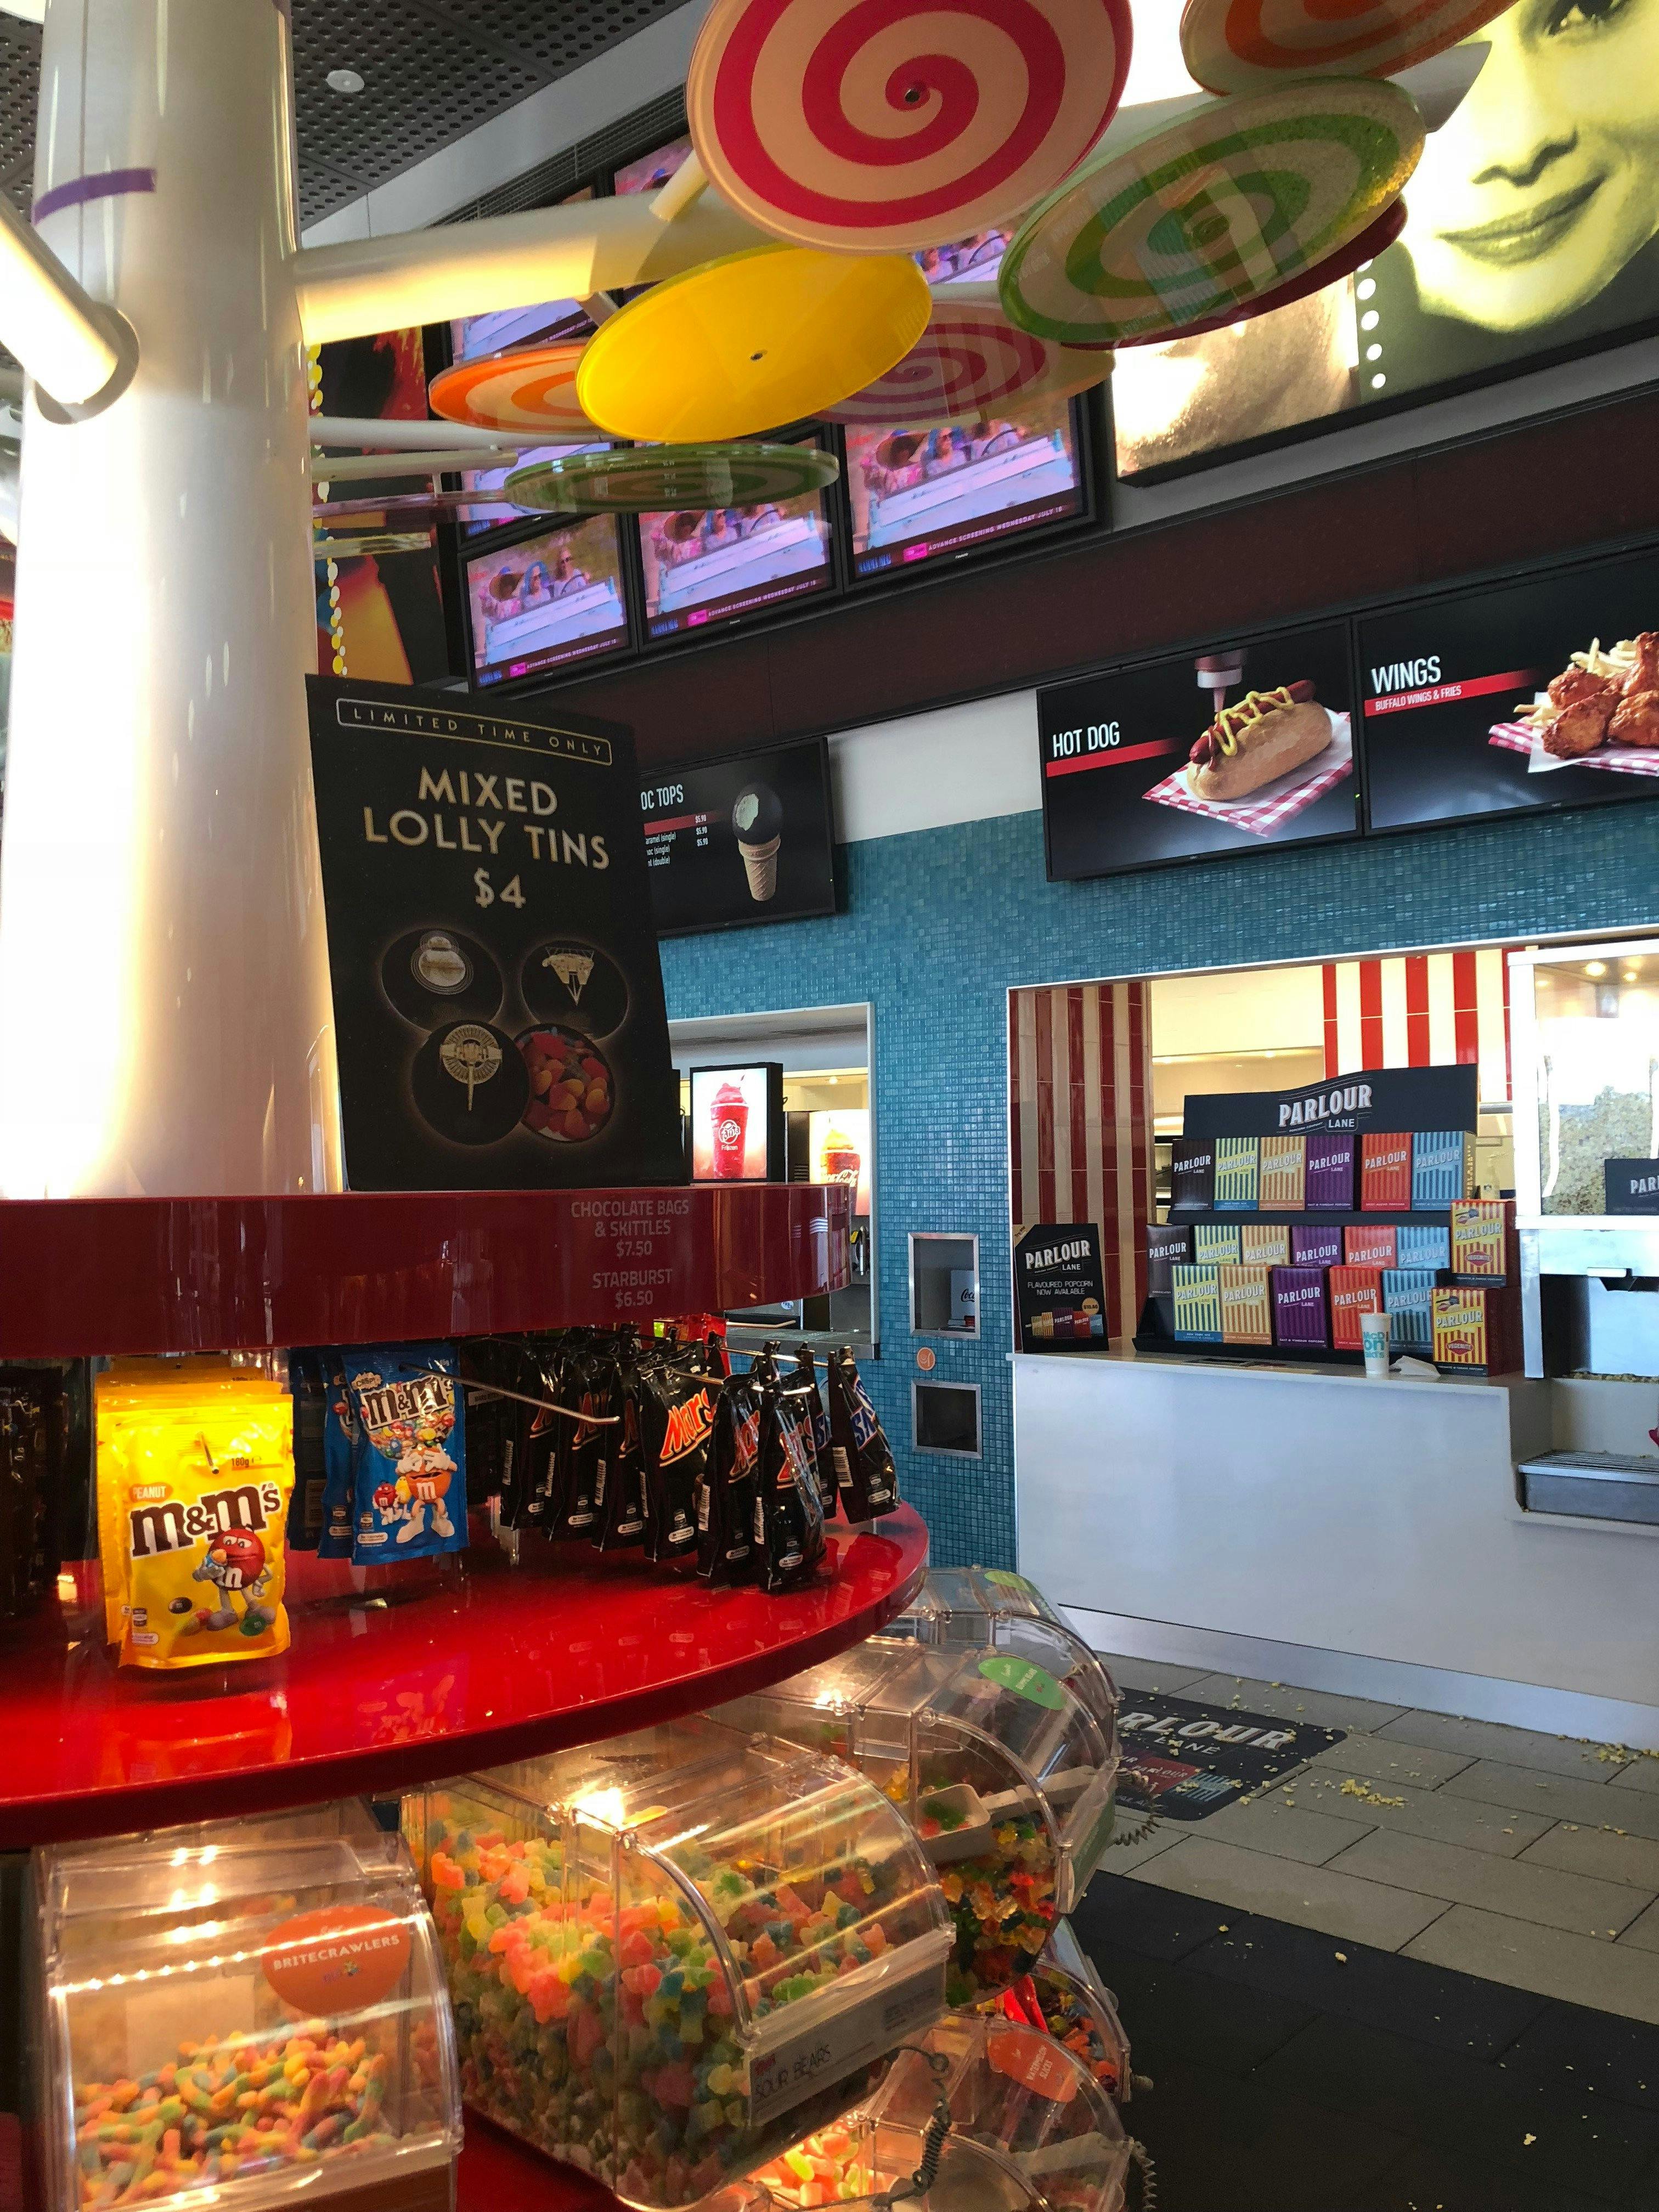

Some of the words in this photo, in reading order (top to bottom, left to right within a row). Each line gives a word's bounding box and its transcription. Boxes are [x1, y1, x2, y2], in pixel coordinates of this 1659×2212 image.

[1371, 655, 1442, 694] WINGS
[1375, 696, 1406, 712] BUFFALO
[1407, 690, 1432, 705] WINGS
[1433, 689, 1440, 700] &
[1441, 685, 1462, 698] FRIES
[354, 707, 458, 732] LIMITED
[478, 723, 531, 743] TIME
[549, 736, 602, 757] ONLY
[1052, 728, 1083, 758] HOT
[1087, 721, 1120, 751] DOG
[418, 766, 558, 816] MIXED
[640, 790, 655, 810] OC
[656, 783, 684, 807] TOPS
[363, 806, 507, 855] LOLLY
[523, 825, 610, 870] TINS
[645, 834, 661, 845] aramel
[475, 867, 527, 909] $4
[1278, 1084, 1373, 1127] PARLOUR
[1328, 1118, 1355, 1128] LANE
[1173, 1154, 1211, 1172] PARLOUR
[1217, 1154, 1256, 1171] PARLOUR
[1262, 1153, 1302, 1172] PARLOUR
[1309, 1152, 1350, 1171] PARLOUR
[1364, 1150, 1407, 1170] PARLOUR
[1414, 1149, 1460, 1169] PARLOUR
[1630, 1175, 1659, 1195] PAR
[571, 1200, 654, 1218] CHOCOLATE
[657, 1199, 690, 1216] BAGS
[595, 1221, 606, 1238] &
[610, 1219, 672, 1237] SKITTLES
[1455, 1222, 1502, 1241] PARLOUR
[616, 1239, 653, 1259] $7.50
[1024, 1239, 1091, 1270] PARLOUR
[1149, 1242, 1187, 1259] PARLOUR
[1198, 1244, 1238, 1261] PARLOUR
[1245, 1243, 1285, 1261] PARLOUR
[1296, 1244, 1338, 1262] PARLOUR
[1348, 1245, 1392, 1263] PARLOUR
[1400, 1246, 1446, 1263] PARLOUR
[591, 1268, 673, 1289] STARBURST
[615, 1289, 653, 1310] $6.50
[1175, 1284, 1217, 1301] PARLOUR
[1223, 1285, 1265, 1302] PARLOUR
[1278, 1286, 1321, 1304] PARLOUR
[1334, 1288, 1376, 1306] PARLOUR
[1436, 1311, 1483, 1329] PARLOUR
[132, 1485, 167, 1500] PEANUT
[129, 1482, 281, 1558] m&m's
[1118, 1712, 1296, 1751] RLOUR
[273, 1934, 401, 1971] BRITECRAWLERS
[755, 2068, 789, 2099] SOUR
[793, 2044, 831, 2078] BEARS
